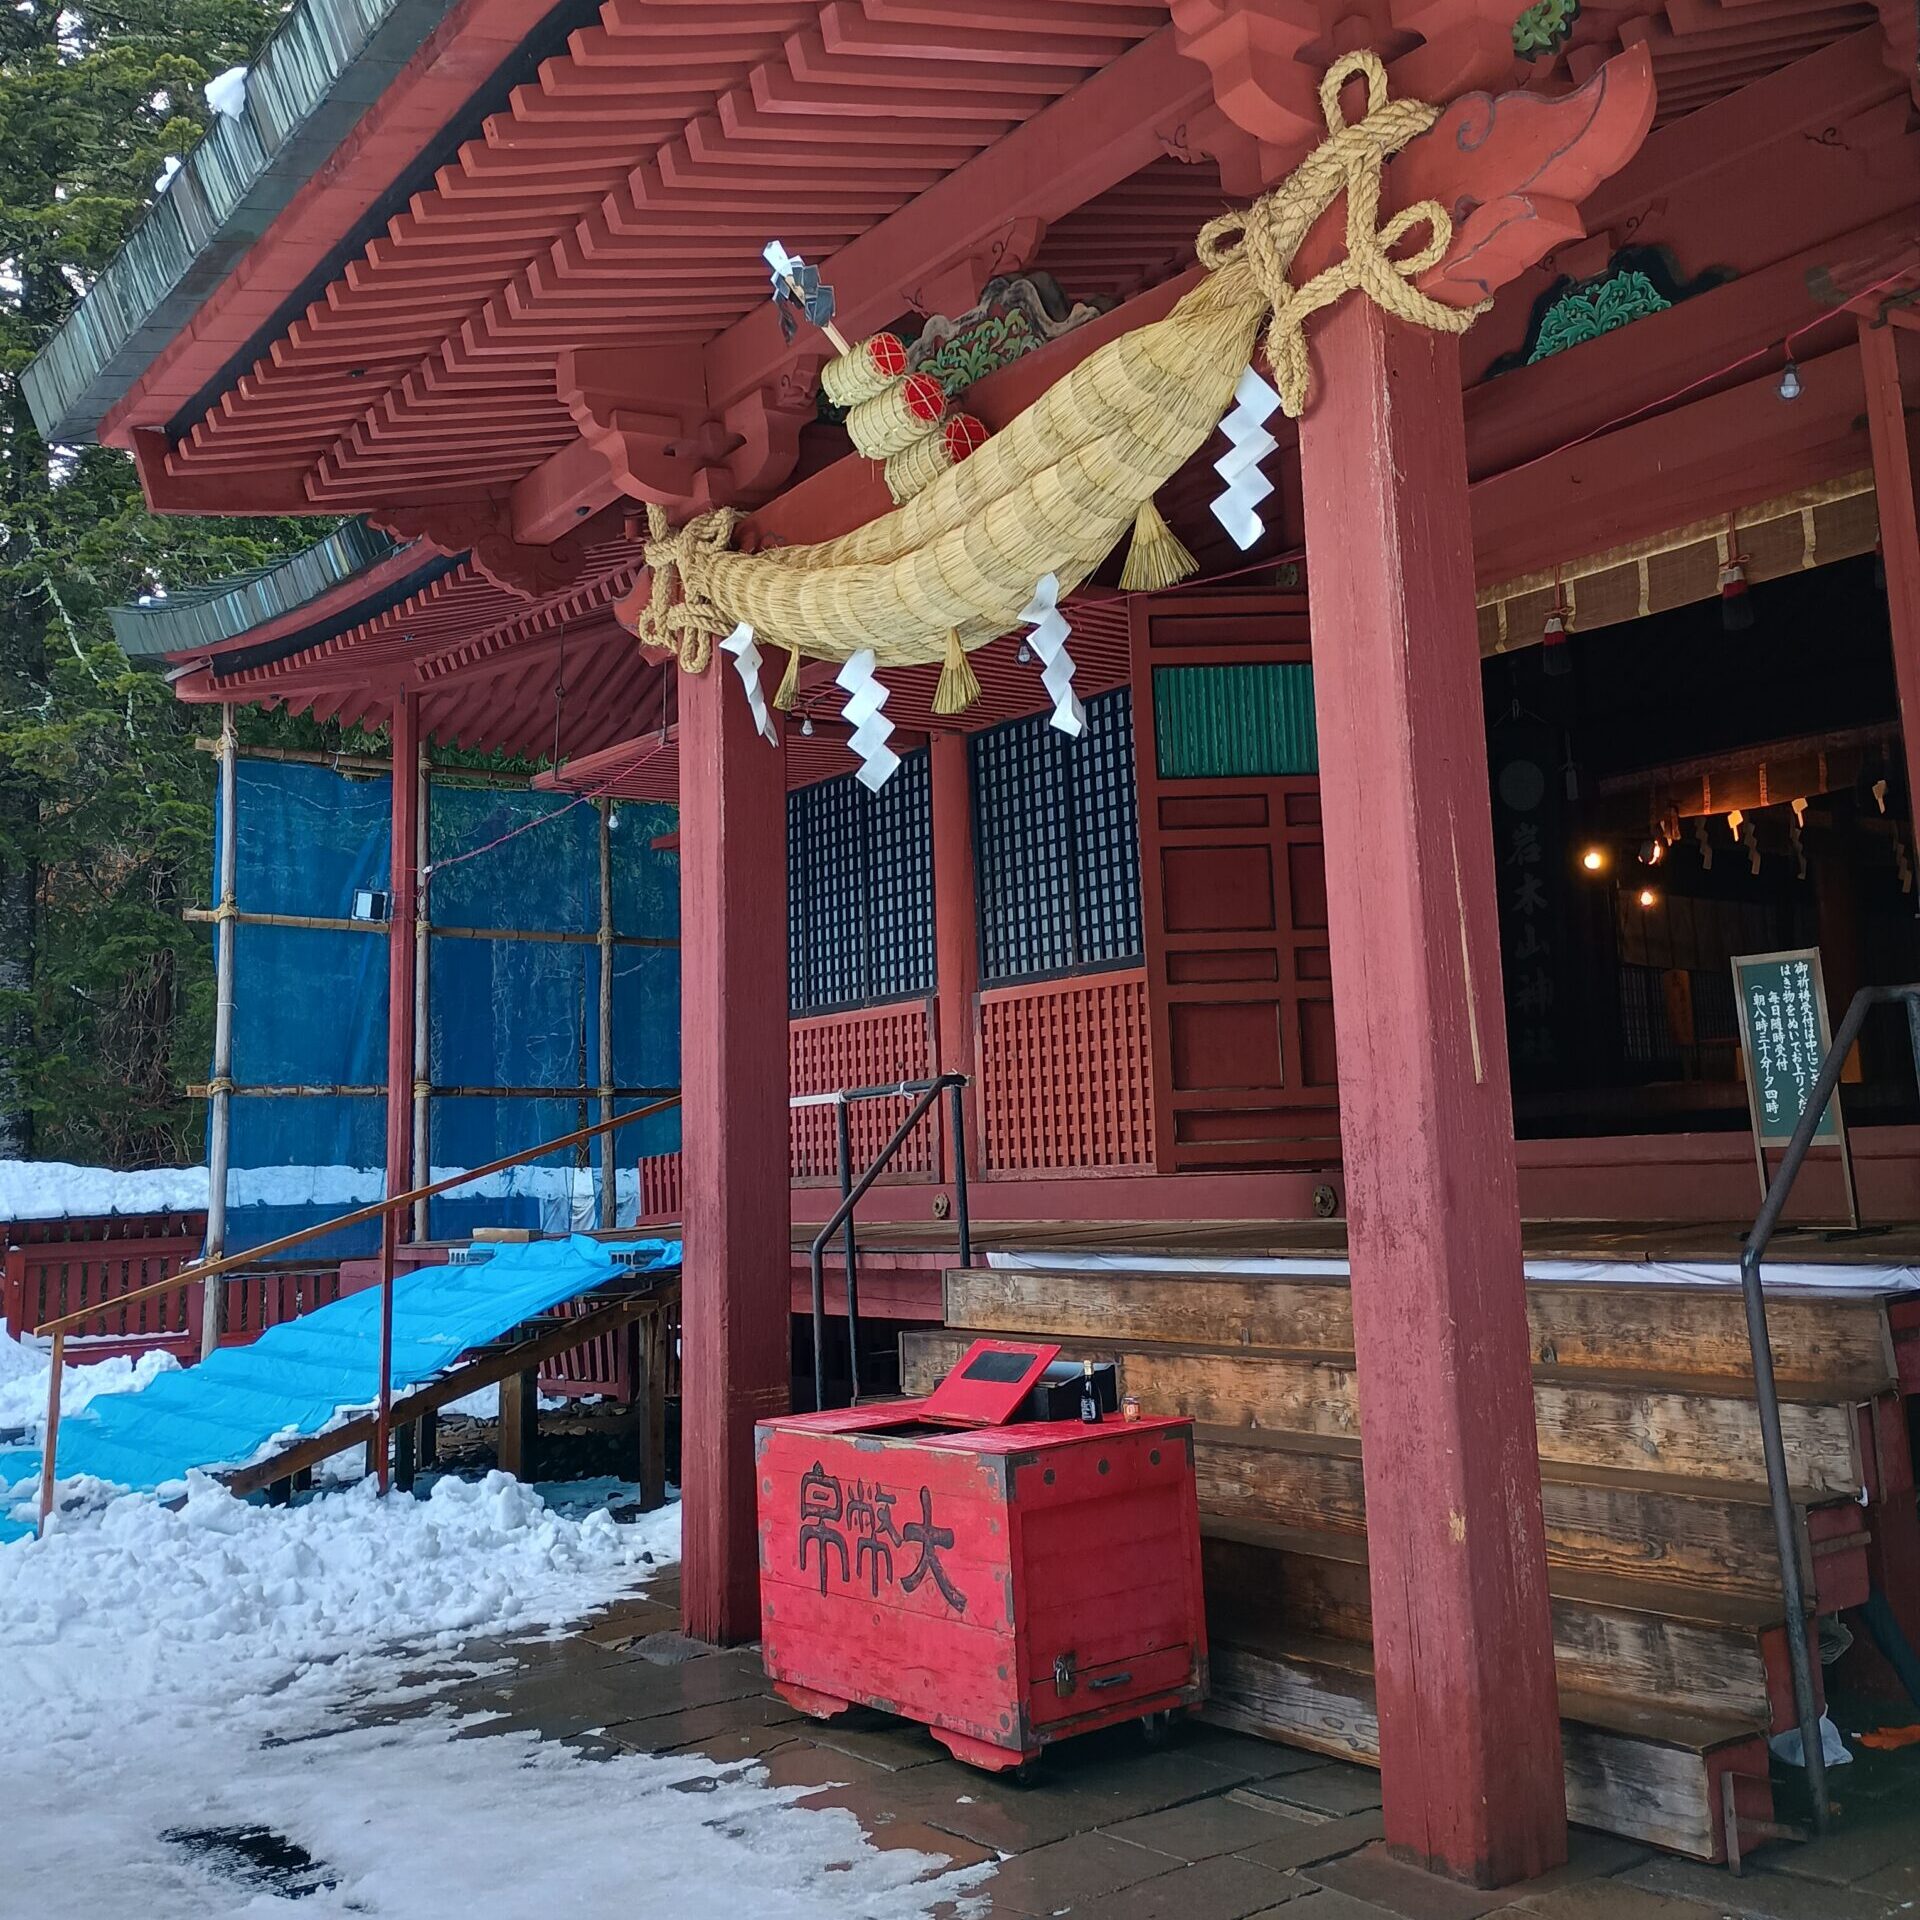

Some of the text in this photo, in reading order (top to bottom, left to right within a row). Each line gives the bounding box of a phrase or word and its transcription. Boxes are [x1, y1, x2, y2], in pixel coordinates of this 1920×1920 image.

[1780, 964, 1808, 1116] はき物をぬいでお上りくだ
[1794, 961, 1825, 1122] 御祈祷受付は中にござ
